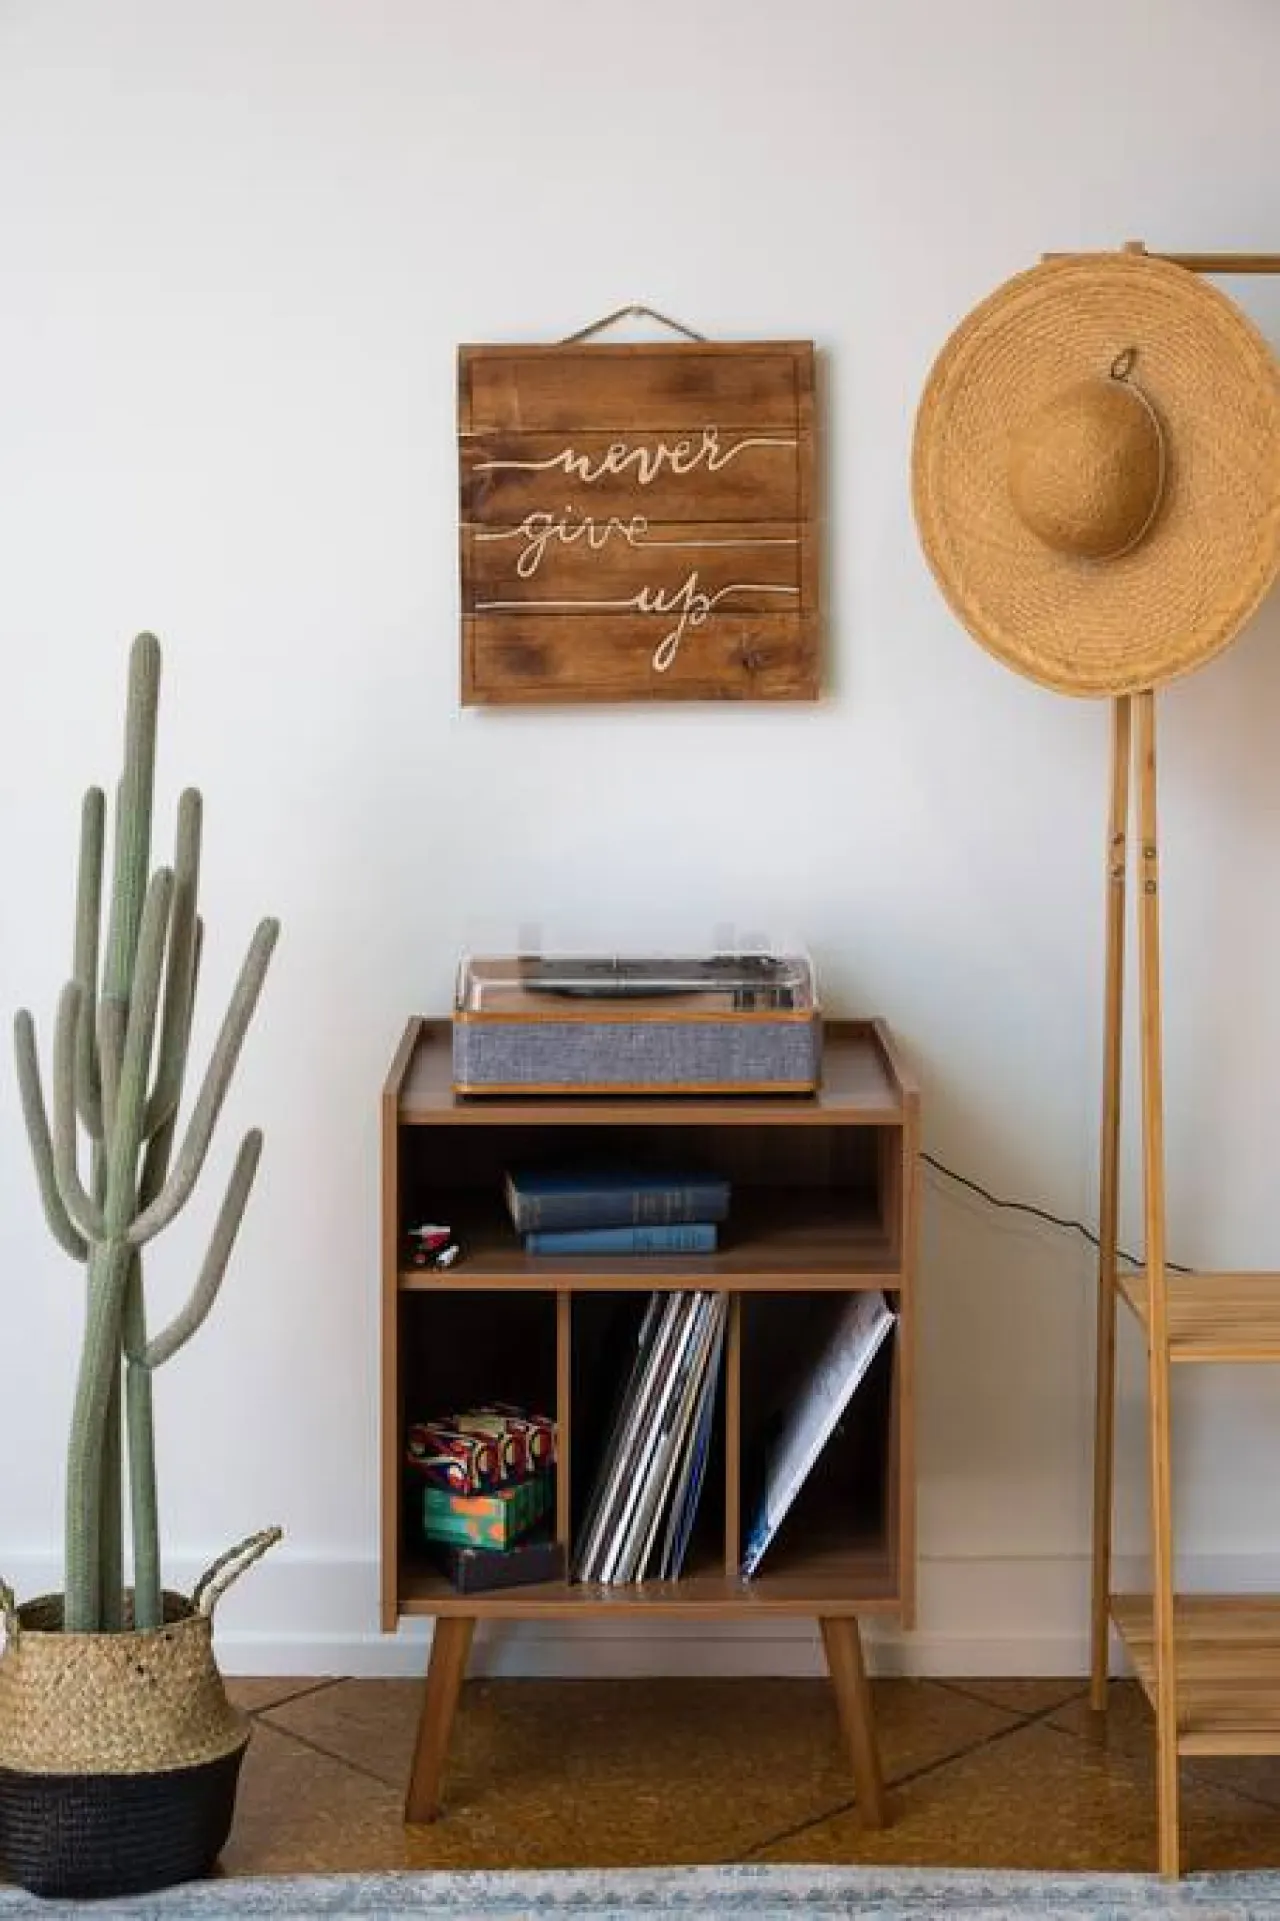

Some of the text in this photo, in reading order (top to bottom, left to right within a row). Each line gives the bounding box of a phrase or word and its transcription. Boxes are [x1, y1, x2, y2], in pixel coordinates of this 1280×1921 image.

[550, 424, 738, 484] never
[516, 504, 648, 577] give
[630, 571, 726, 672] up
